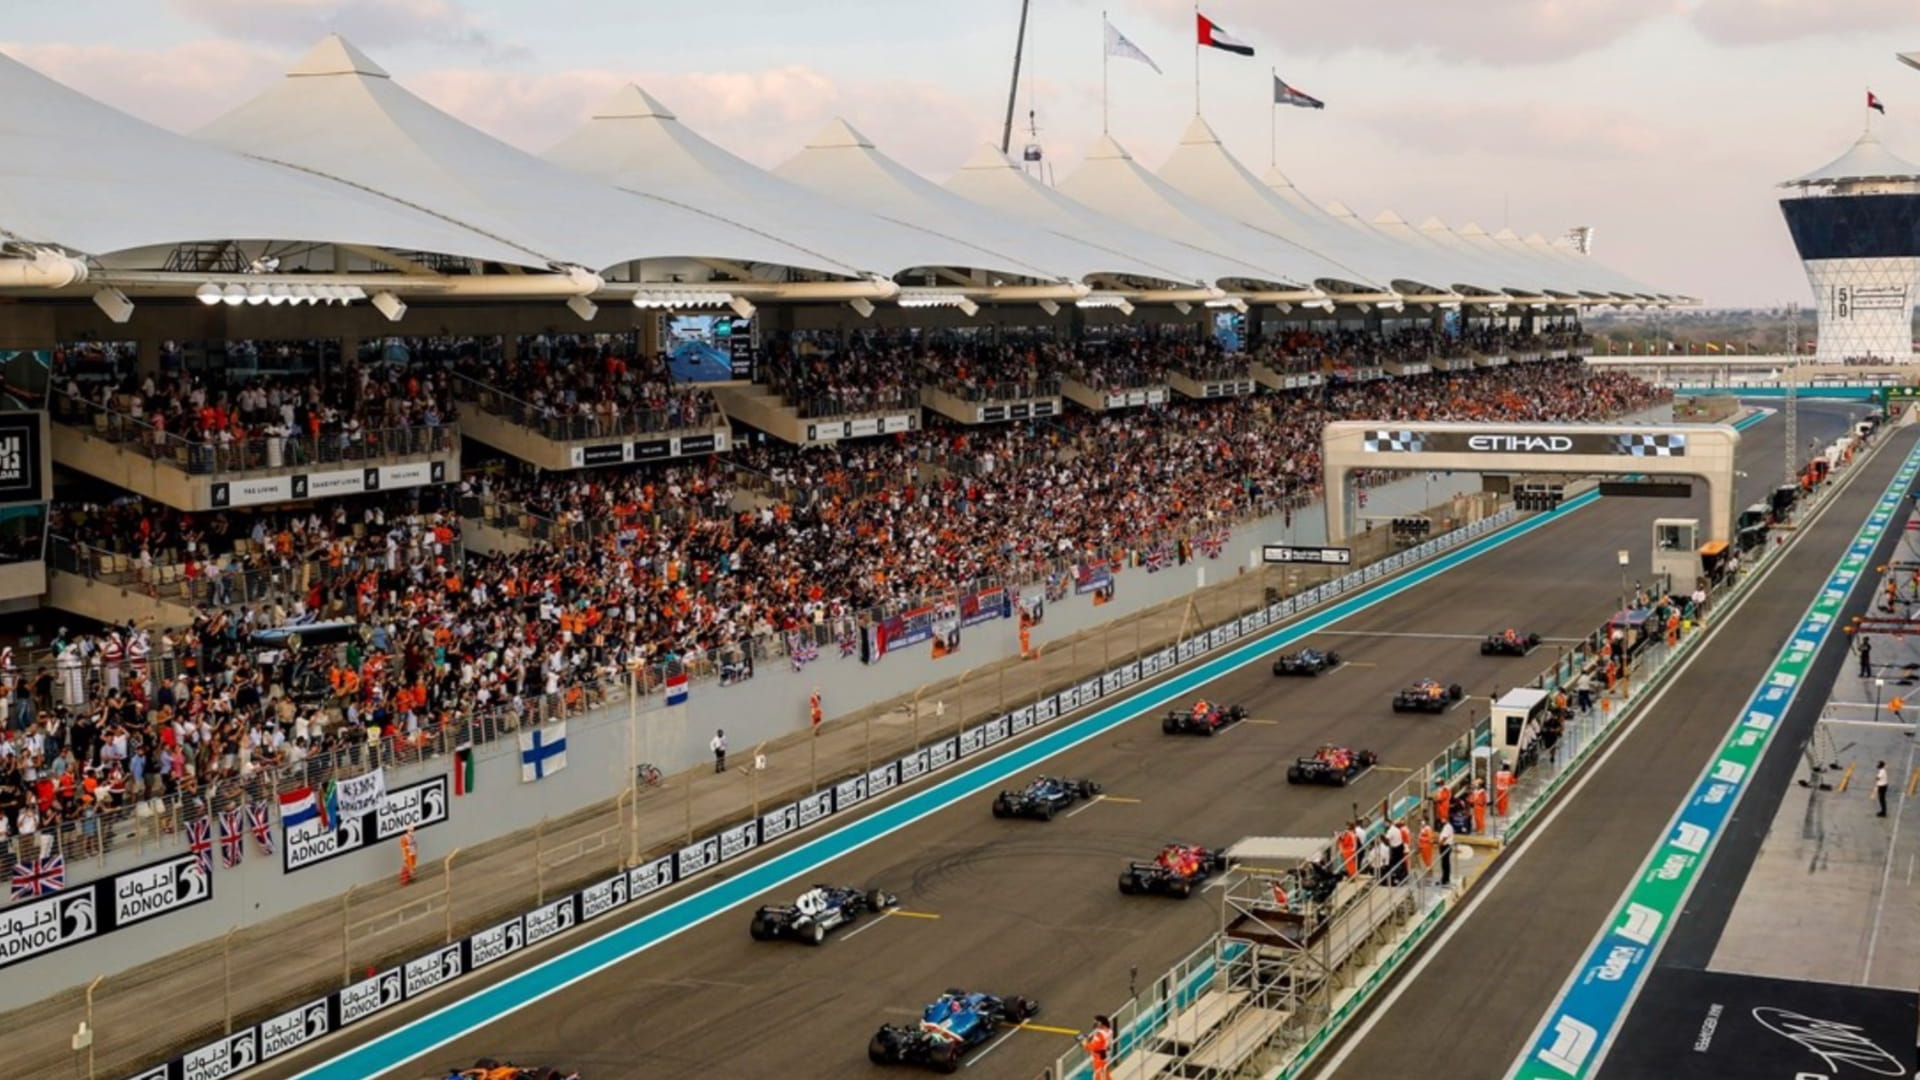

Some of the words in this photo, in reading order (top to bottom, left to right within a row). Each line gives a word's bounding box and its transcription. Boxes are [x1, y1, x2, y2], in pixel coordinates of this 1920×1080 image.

[1468, 435, 1573, 451] ETIHAD
[380, 810, 420, 834] ADNOC
[290, 838, 335, 864] ADNOC
[120, 890, 174, 920] ADNOC
[584, 897, 611, 916] ADNOC
[0, 927, 57, 957] ADNOC
[528, 920, 557, 940] ADNOC
[473, 943, 504, 963] ADNOC
[407, 969, 442, 993] ADNOC
[343, 995, 380, 1020] ADNOC
[264, 1029, 304, 1056] ADNOC
